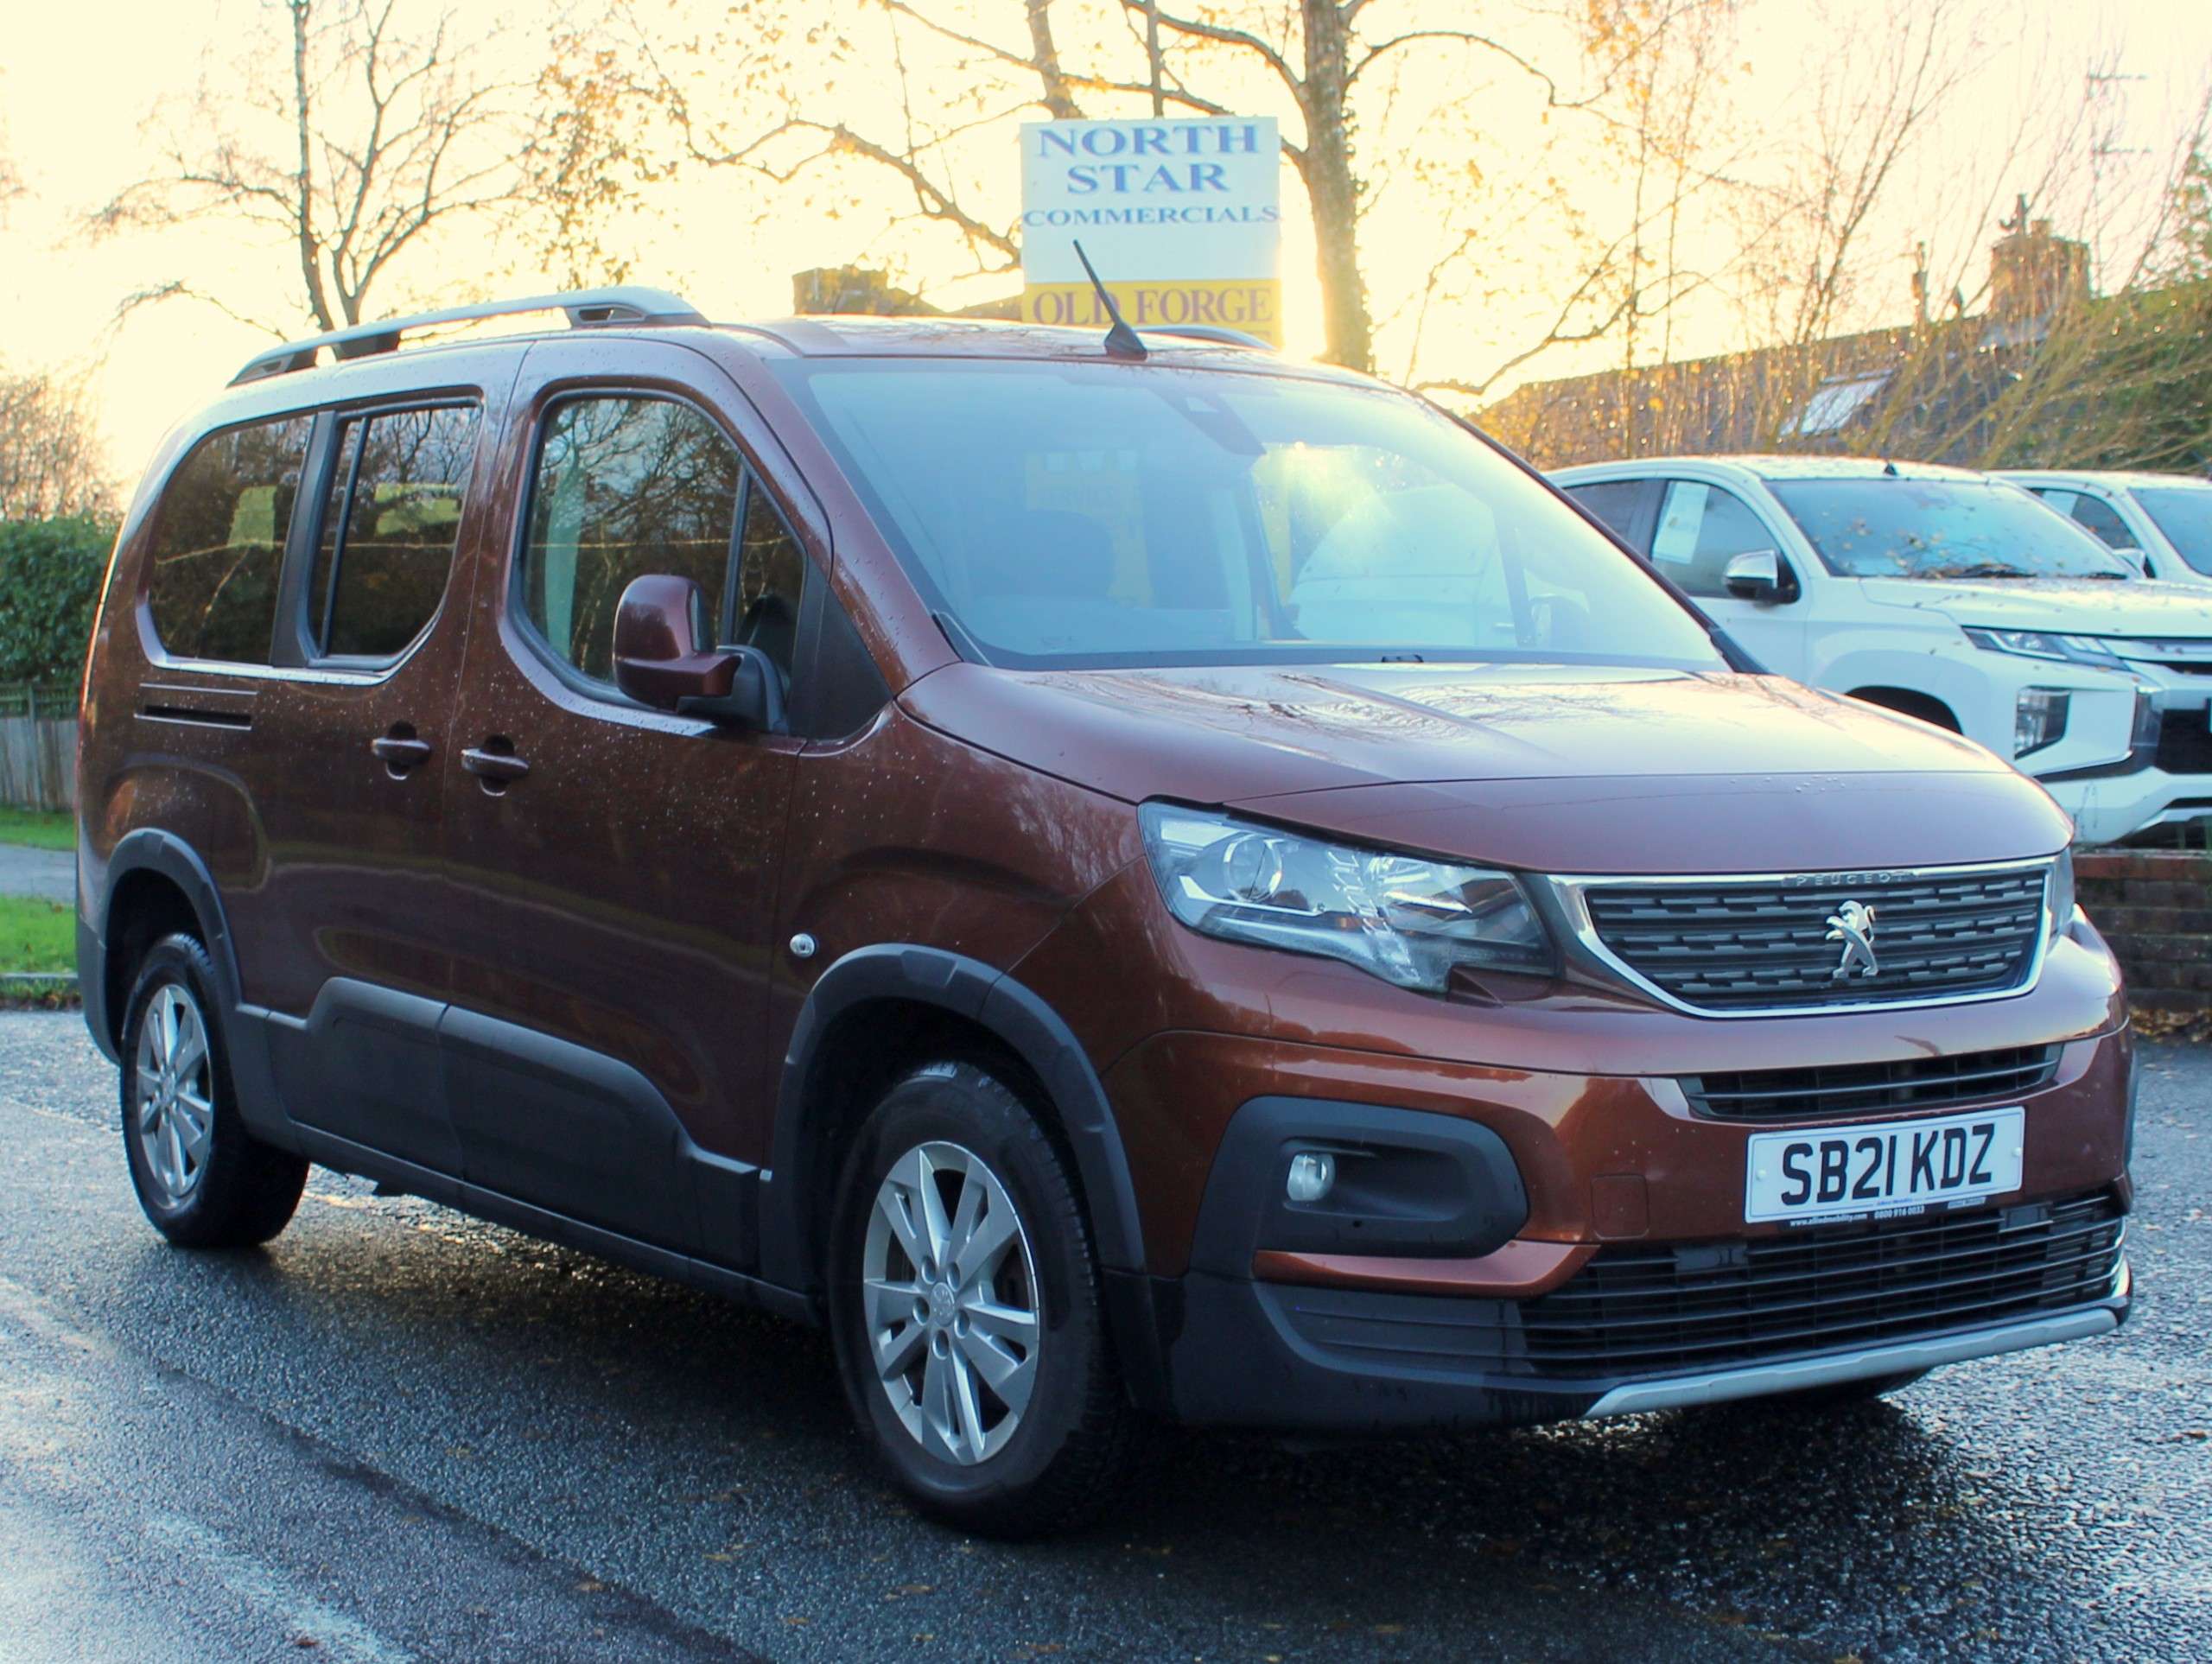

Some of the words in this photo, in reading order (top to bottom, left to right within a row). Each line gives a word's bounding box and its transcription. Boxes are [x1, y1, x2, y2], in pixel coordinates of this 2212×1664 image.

[1037, 124, 1259, 157] NORTH
[1067, 162, 1230, 194] STAR
[1023, 206, 1280, 227] COMMERCIALS
[1033, 290, 1121, 325] OLD
[1134, 287, 1274, 324] FORGE
[1781, 1135, 1897, 1206] SB21
[1910, 1123, 1995, 1193] KDZ
